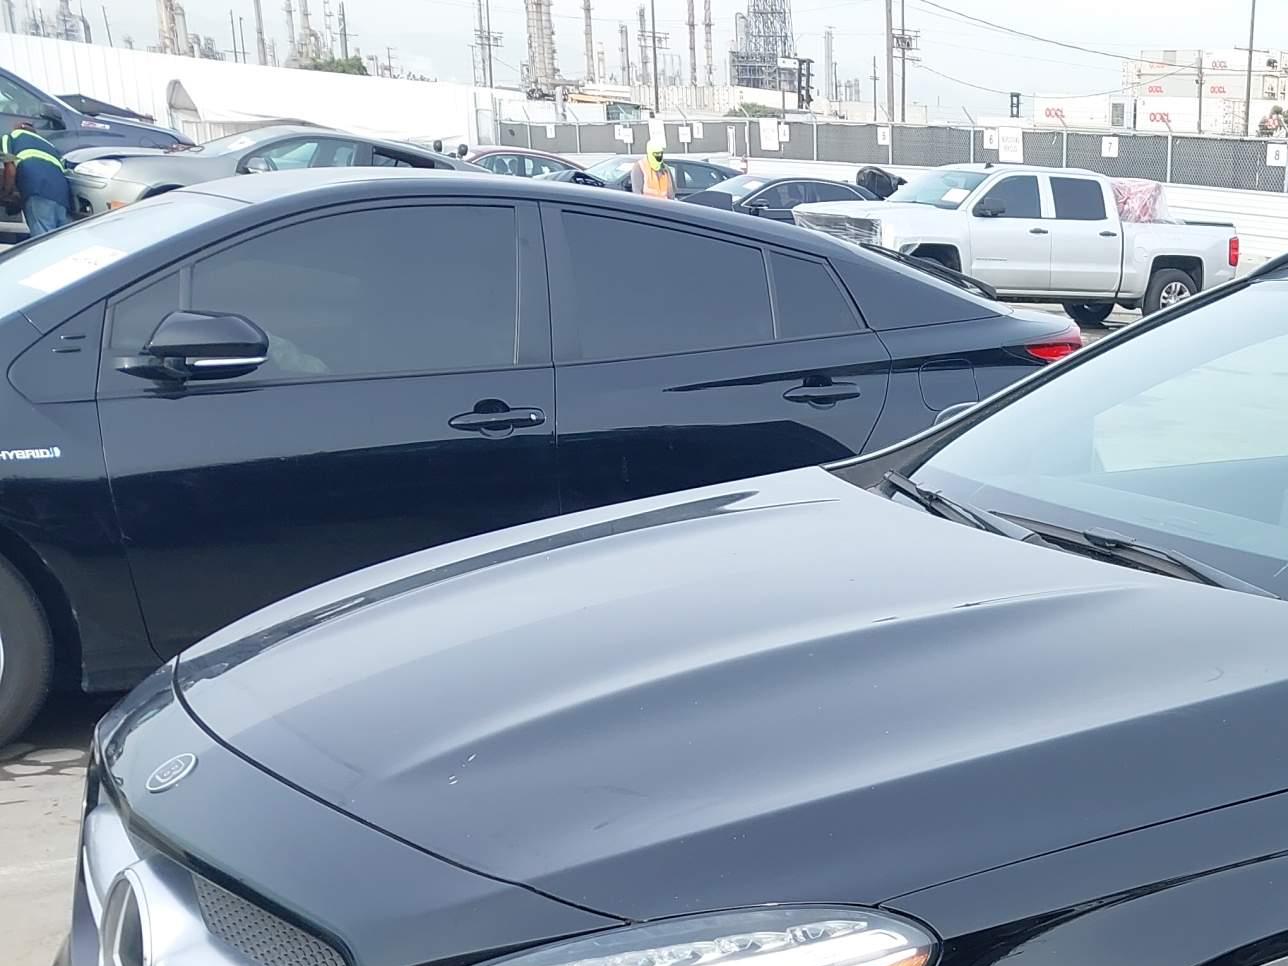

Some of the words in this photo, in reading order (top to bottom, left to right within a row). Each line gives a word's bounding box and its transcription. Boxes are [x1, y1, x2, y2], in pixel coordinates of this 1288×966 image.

[988, 134, 994, 145] 6
[1107, 142, 1113, 152] 7
[1274, 150, 1280, 161] 8
